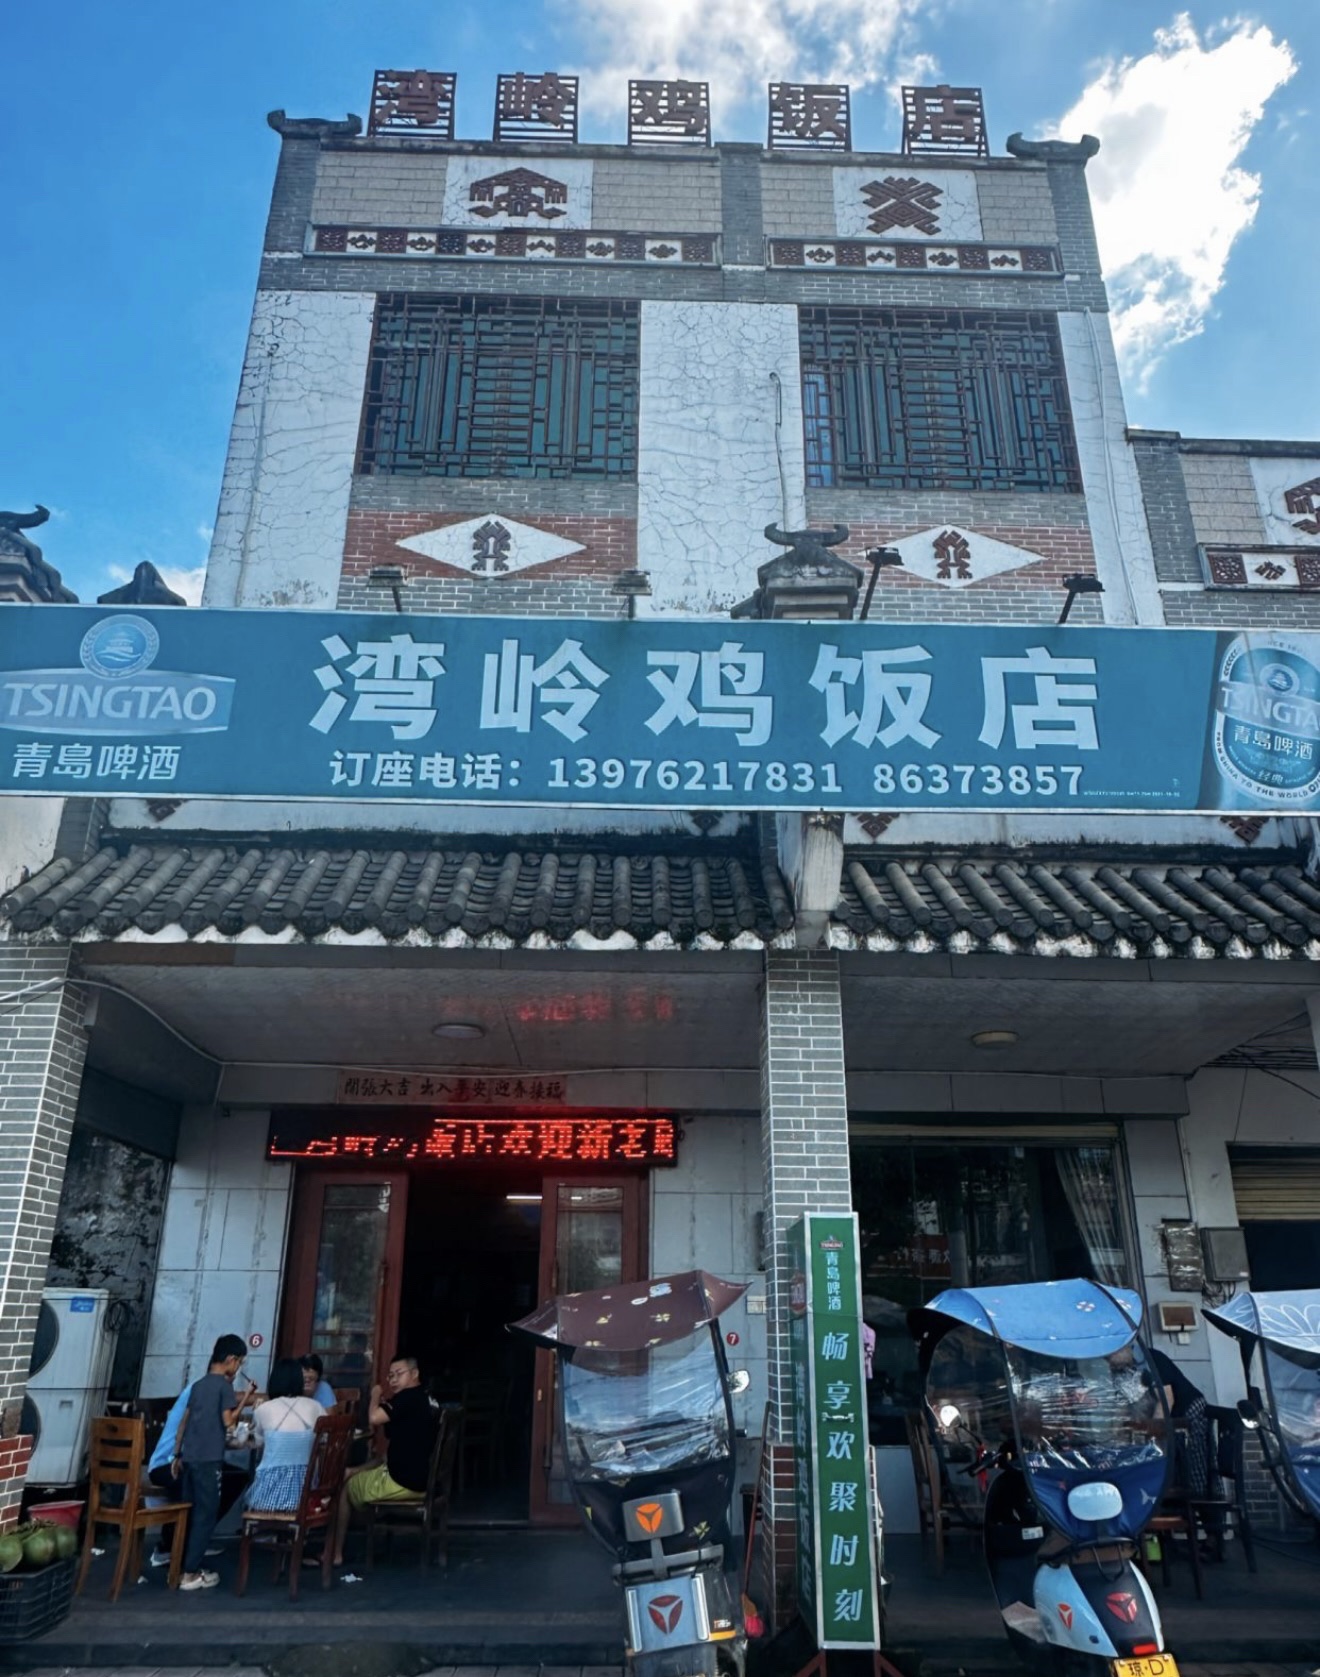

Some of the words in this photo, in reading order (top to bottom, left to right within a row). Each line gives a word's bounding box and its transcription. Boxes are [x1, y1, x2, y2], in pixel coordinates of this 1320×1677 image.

[4, 683, 217, 721] TSINGTAO
[309, 634, 1099, 750] 湾岭鸡饭店
[1221, 687, 1320, 731] TSINGTA
[1233, 724, 1314, 760] 青岛啤酒
[12, 743, 180, 781] 青岛啤酒
[548, 758, 843, 795] 13976217831
[873, 763, 1084, 797] 86373857
[1256, 787, 1274, 798] THE
[825, 1251, 842, 1311] 青岛啤酒
[252, 1335, 260, 1346] 6
[729, 1333, 736, 1345] 7
[821, 1331, 863, 1622] 畅享欢聚时刻
